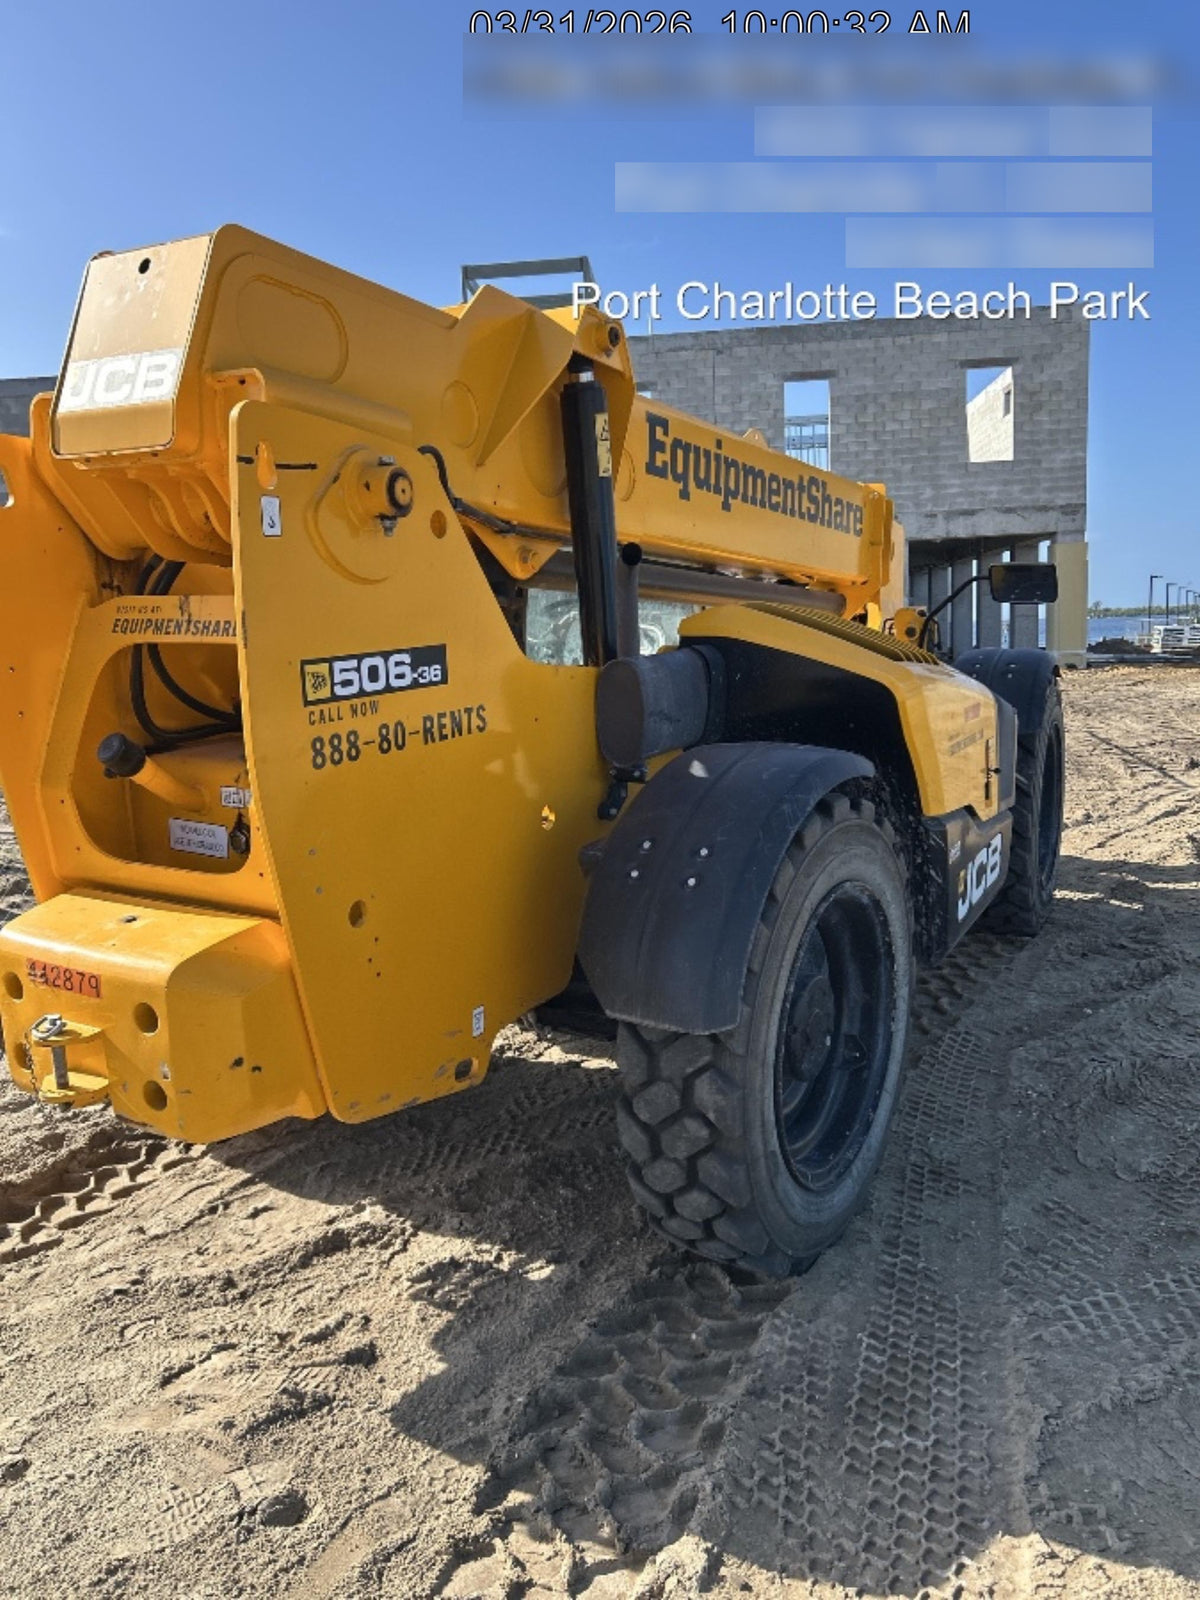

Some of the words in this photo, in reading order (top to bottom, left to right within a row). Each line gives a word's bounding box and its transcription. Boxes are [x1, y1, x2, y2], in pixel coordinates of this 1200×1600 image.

[57, 352, 180, 412] JCB
[645, 410, 864, 537] EquipmentShare
[332, 653, 442, 696] 506-36
[308, 706, 344, 726] CALL
[350, 700, 380, 719] NOW
[311, 704, 488, 771] 888-80-RENTS
[958, 833, 1002, 923] JCB
